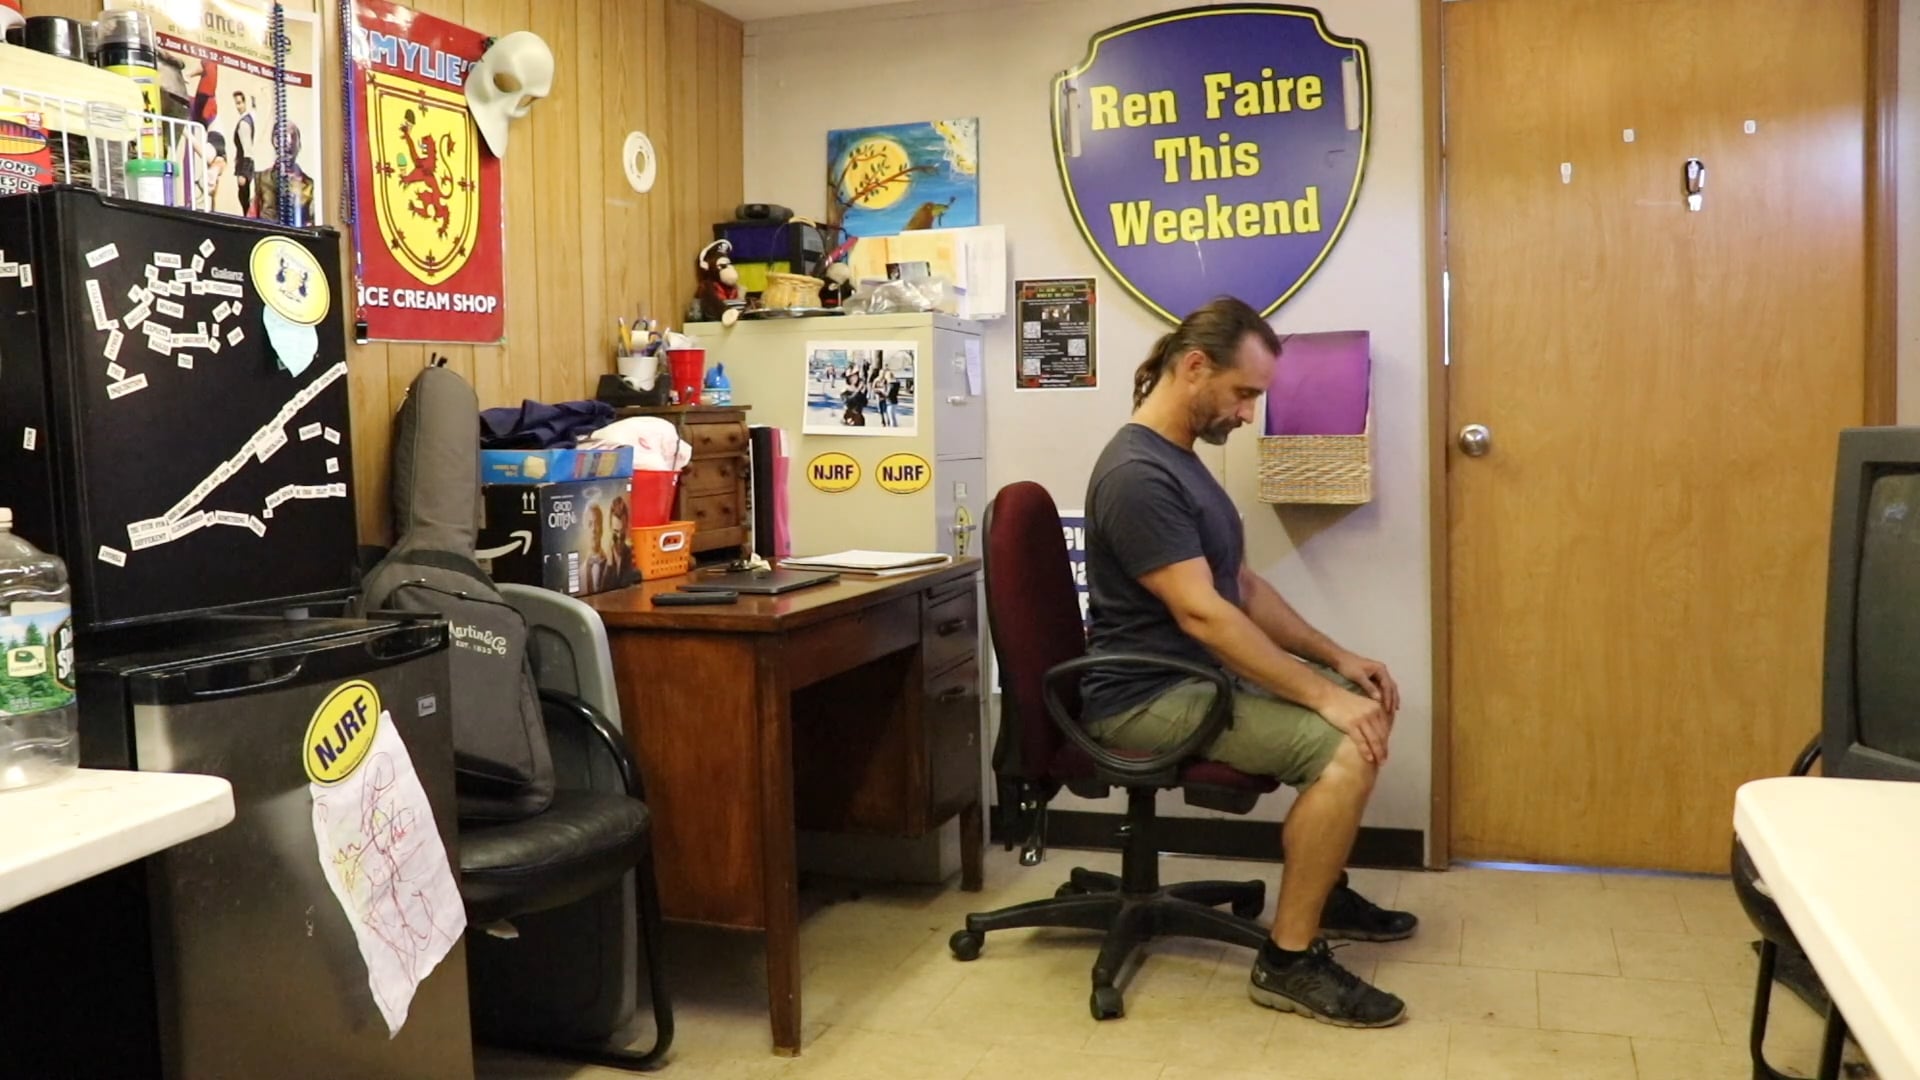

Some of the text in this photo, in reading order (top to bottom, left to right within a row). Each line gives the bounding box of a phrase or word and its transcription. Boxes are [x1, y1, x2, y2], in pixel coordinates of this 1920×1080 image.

[1089, 67, 1322, 131] Ren Faire
[1154, 132, 1260, 183] This
[1109, 186, 1321, 247] Weekend
[357, 286, 497, 314] ICE CREAM SHOP
[813, 464, 854, 480] NJRF
[882, 465, 924, 482] NJRF
[314, 695, 368, 771] NJRF
